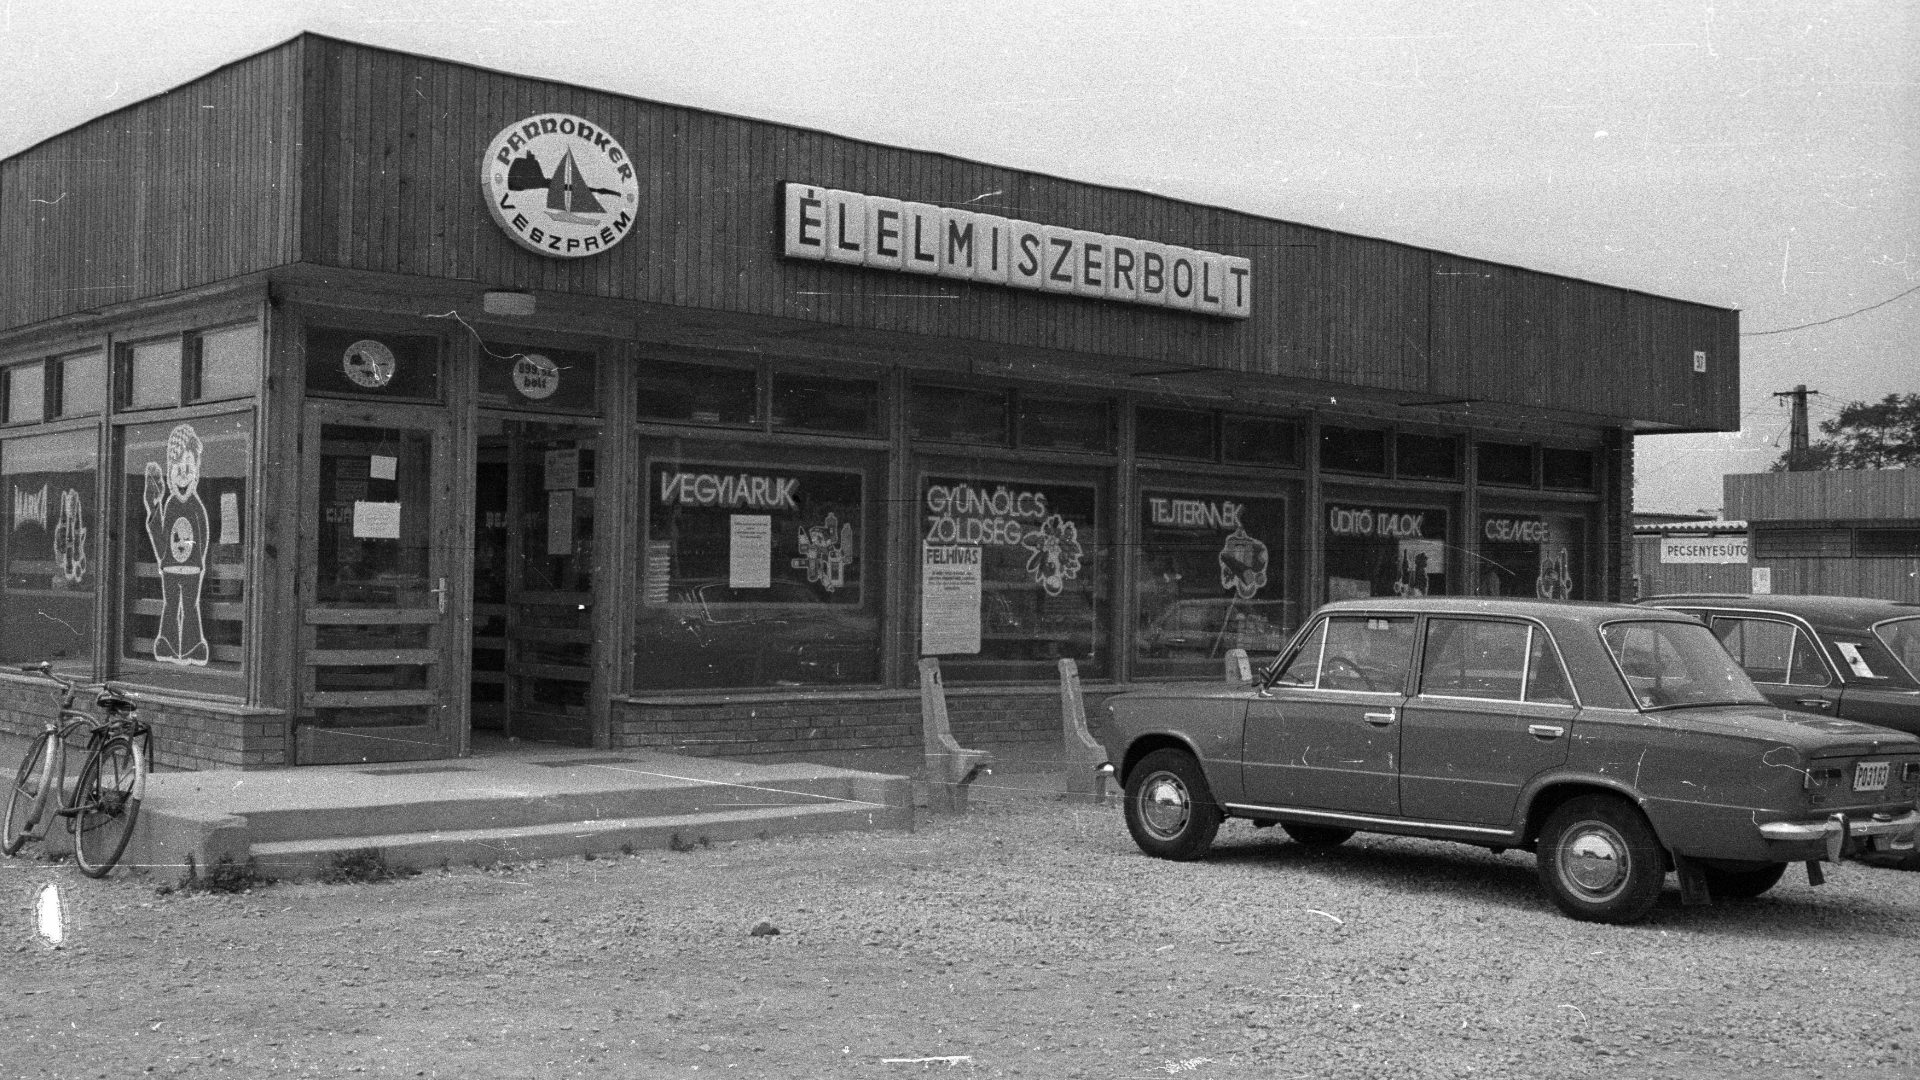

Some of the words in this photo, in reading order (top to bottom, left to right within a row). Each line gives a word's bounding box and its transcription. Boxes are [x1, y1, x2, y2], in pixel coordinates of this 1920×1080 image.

[497, 118, 632, 184] PANNONKER
[500, 192, 630, 252] VESZPRÉM
[799, 189, 1249, 308] ÉLELMISZERBOLT
[524, 375, 547, 389] bolt
[661, 471, 799, 509] VEGYIÁRUK
[927, 483, 1045, 517] GYÜMÖLCS
[926, 512, 1021, 544] ZÖLDSÉG
[1485, 519, 1548, 541] CSEMEGE
